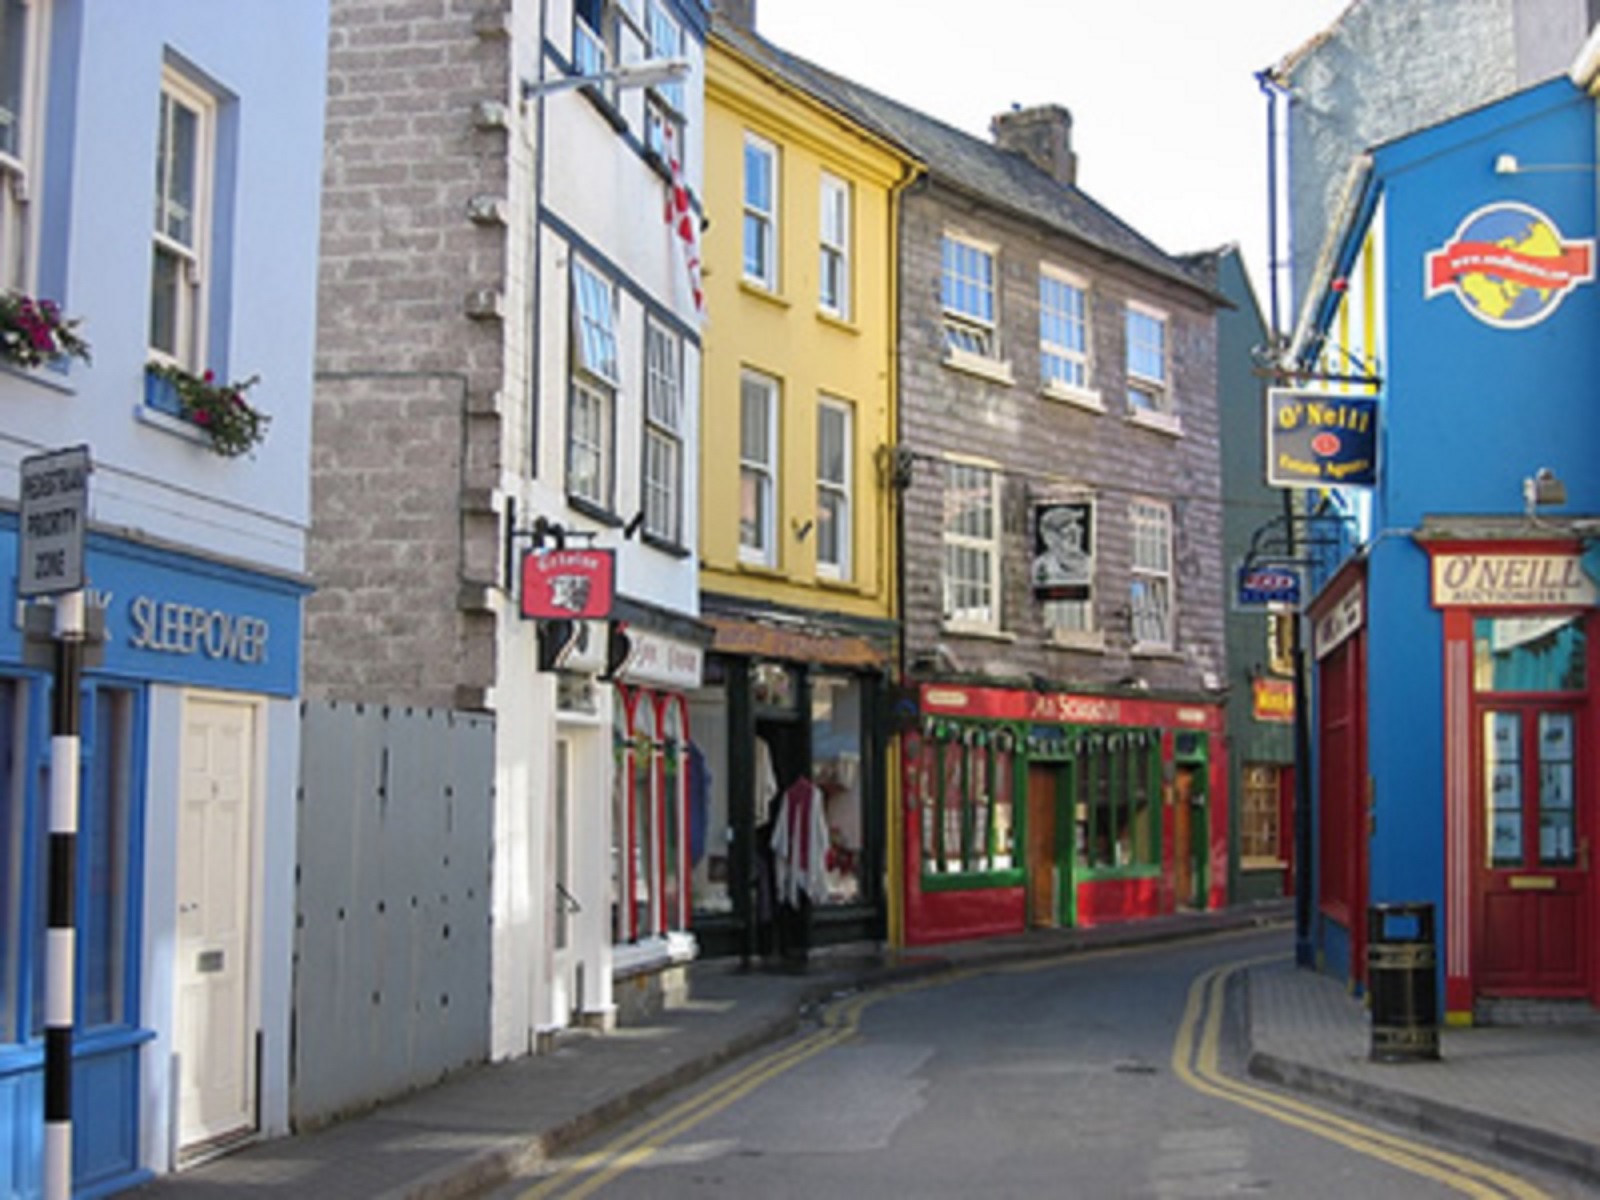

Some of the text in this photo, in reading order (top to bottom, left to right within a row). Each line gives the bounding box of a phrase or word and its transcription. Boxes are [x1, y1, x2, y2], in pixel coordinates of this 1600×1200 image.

[1279, 402, 1369, 433] O'Neill
[34, 548, 66, 580] ZONE
[1442, 555, 1582, 589] O'NEILL
[129, 595, 269, 663] SLEEPOVER
